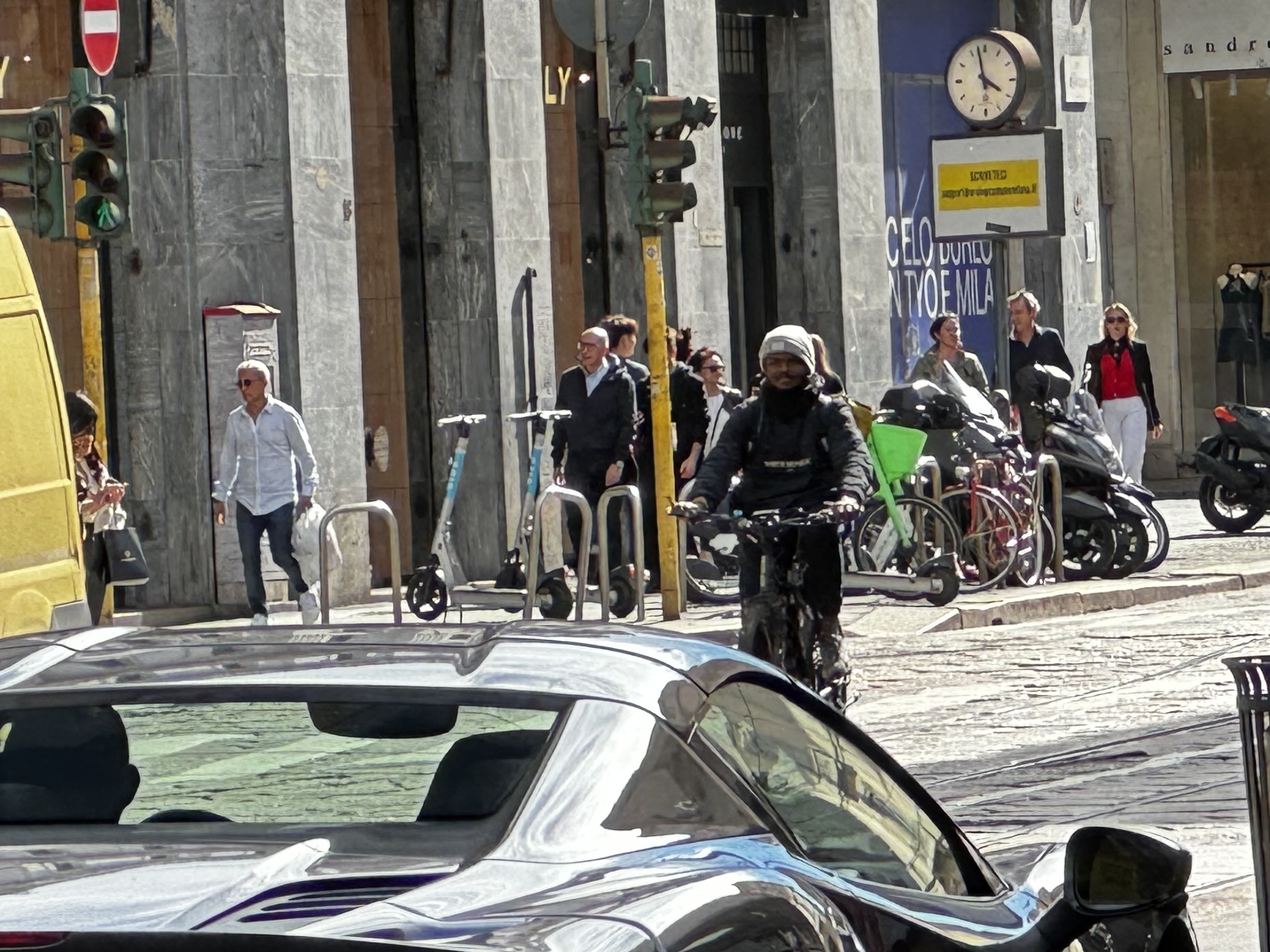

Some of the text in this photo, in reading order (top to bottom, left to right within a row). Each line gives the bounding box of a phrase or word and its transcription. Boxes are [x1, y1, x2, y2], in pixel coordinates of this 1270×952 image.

[1163, 36, 1270, 56] sandr
[544, 65, 572, 105] LY
[885, 216, 933, 268] CELO
